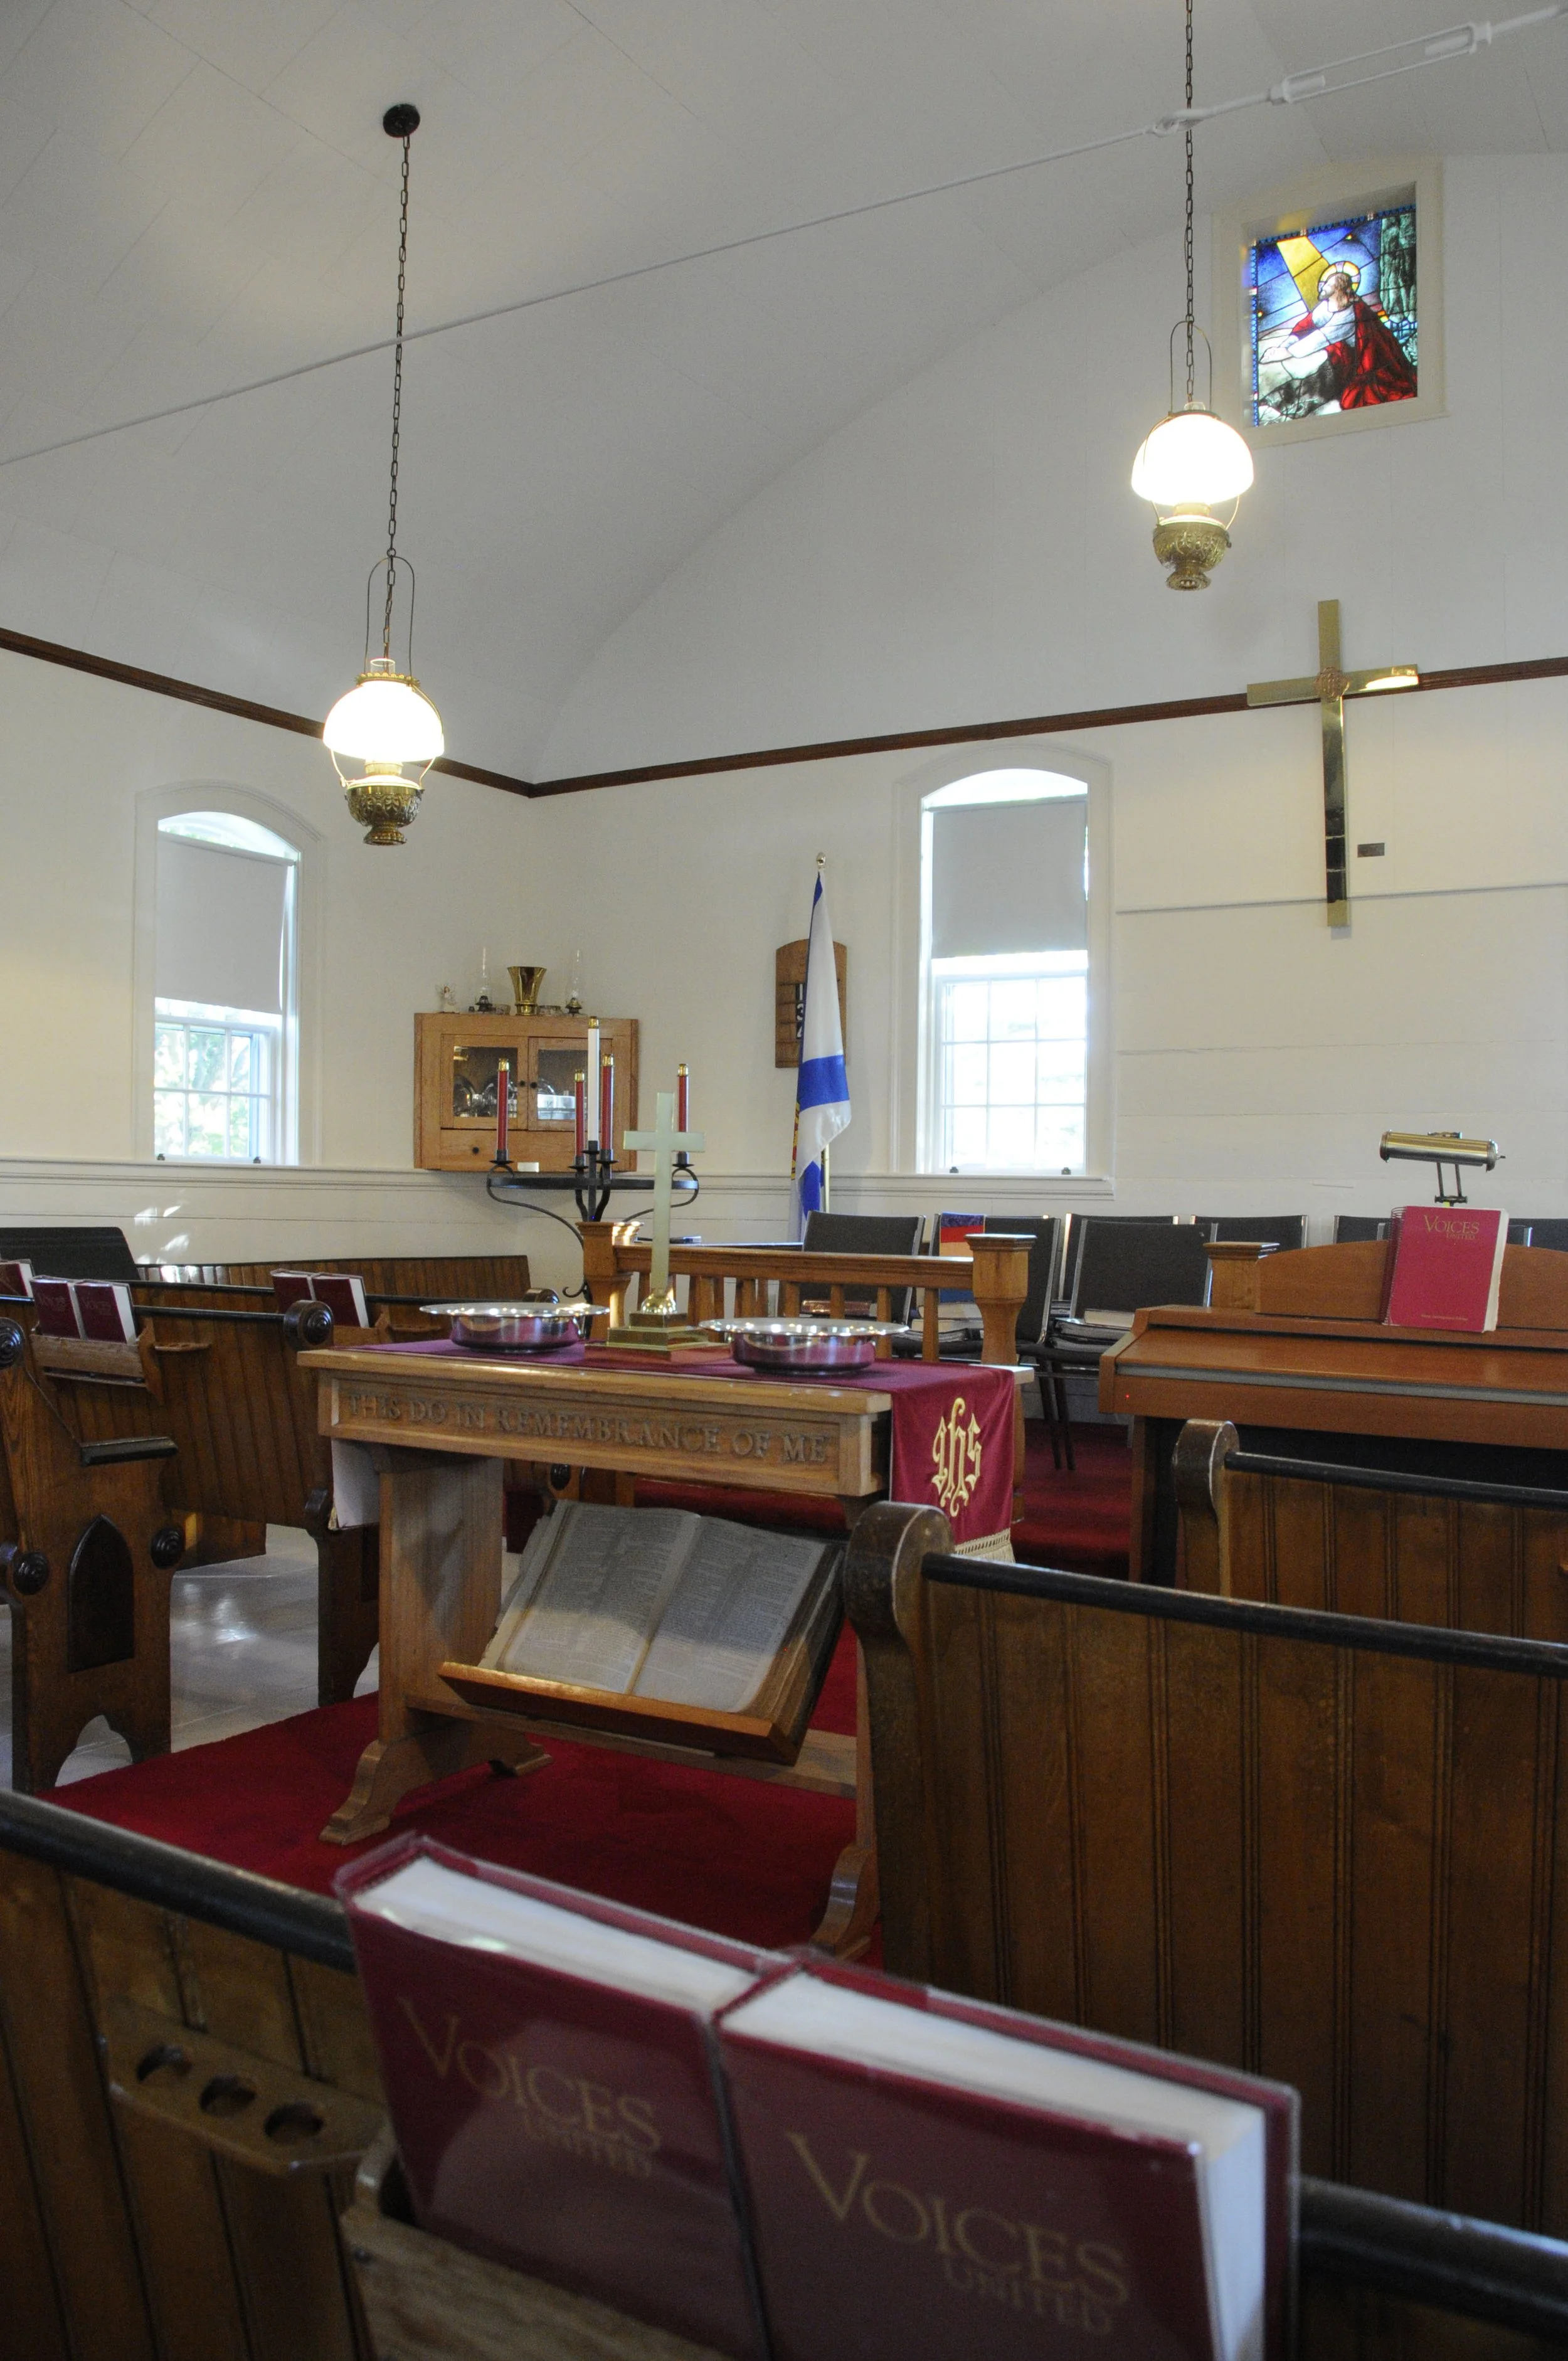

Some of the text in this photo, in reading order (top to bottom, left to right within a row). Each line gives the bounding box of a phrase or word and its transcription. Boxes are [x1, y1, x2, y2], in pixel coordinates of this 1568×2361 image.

[1424, 1214, 1480, 1234] VOICES
[349, 1393, 831, 1463] THIS DO IN REMEMBRANCE OF ME
[395, 1993, 662, 2153] VOICES
[783, 2129, 1130, 2306] VOICES
